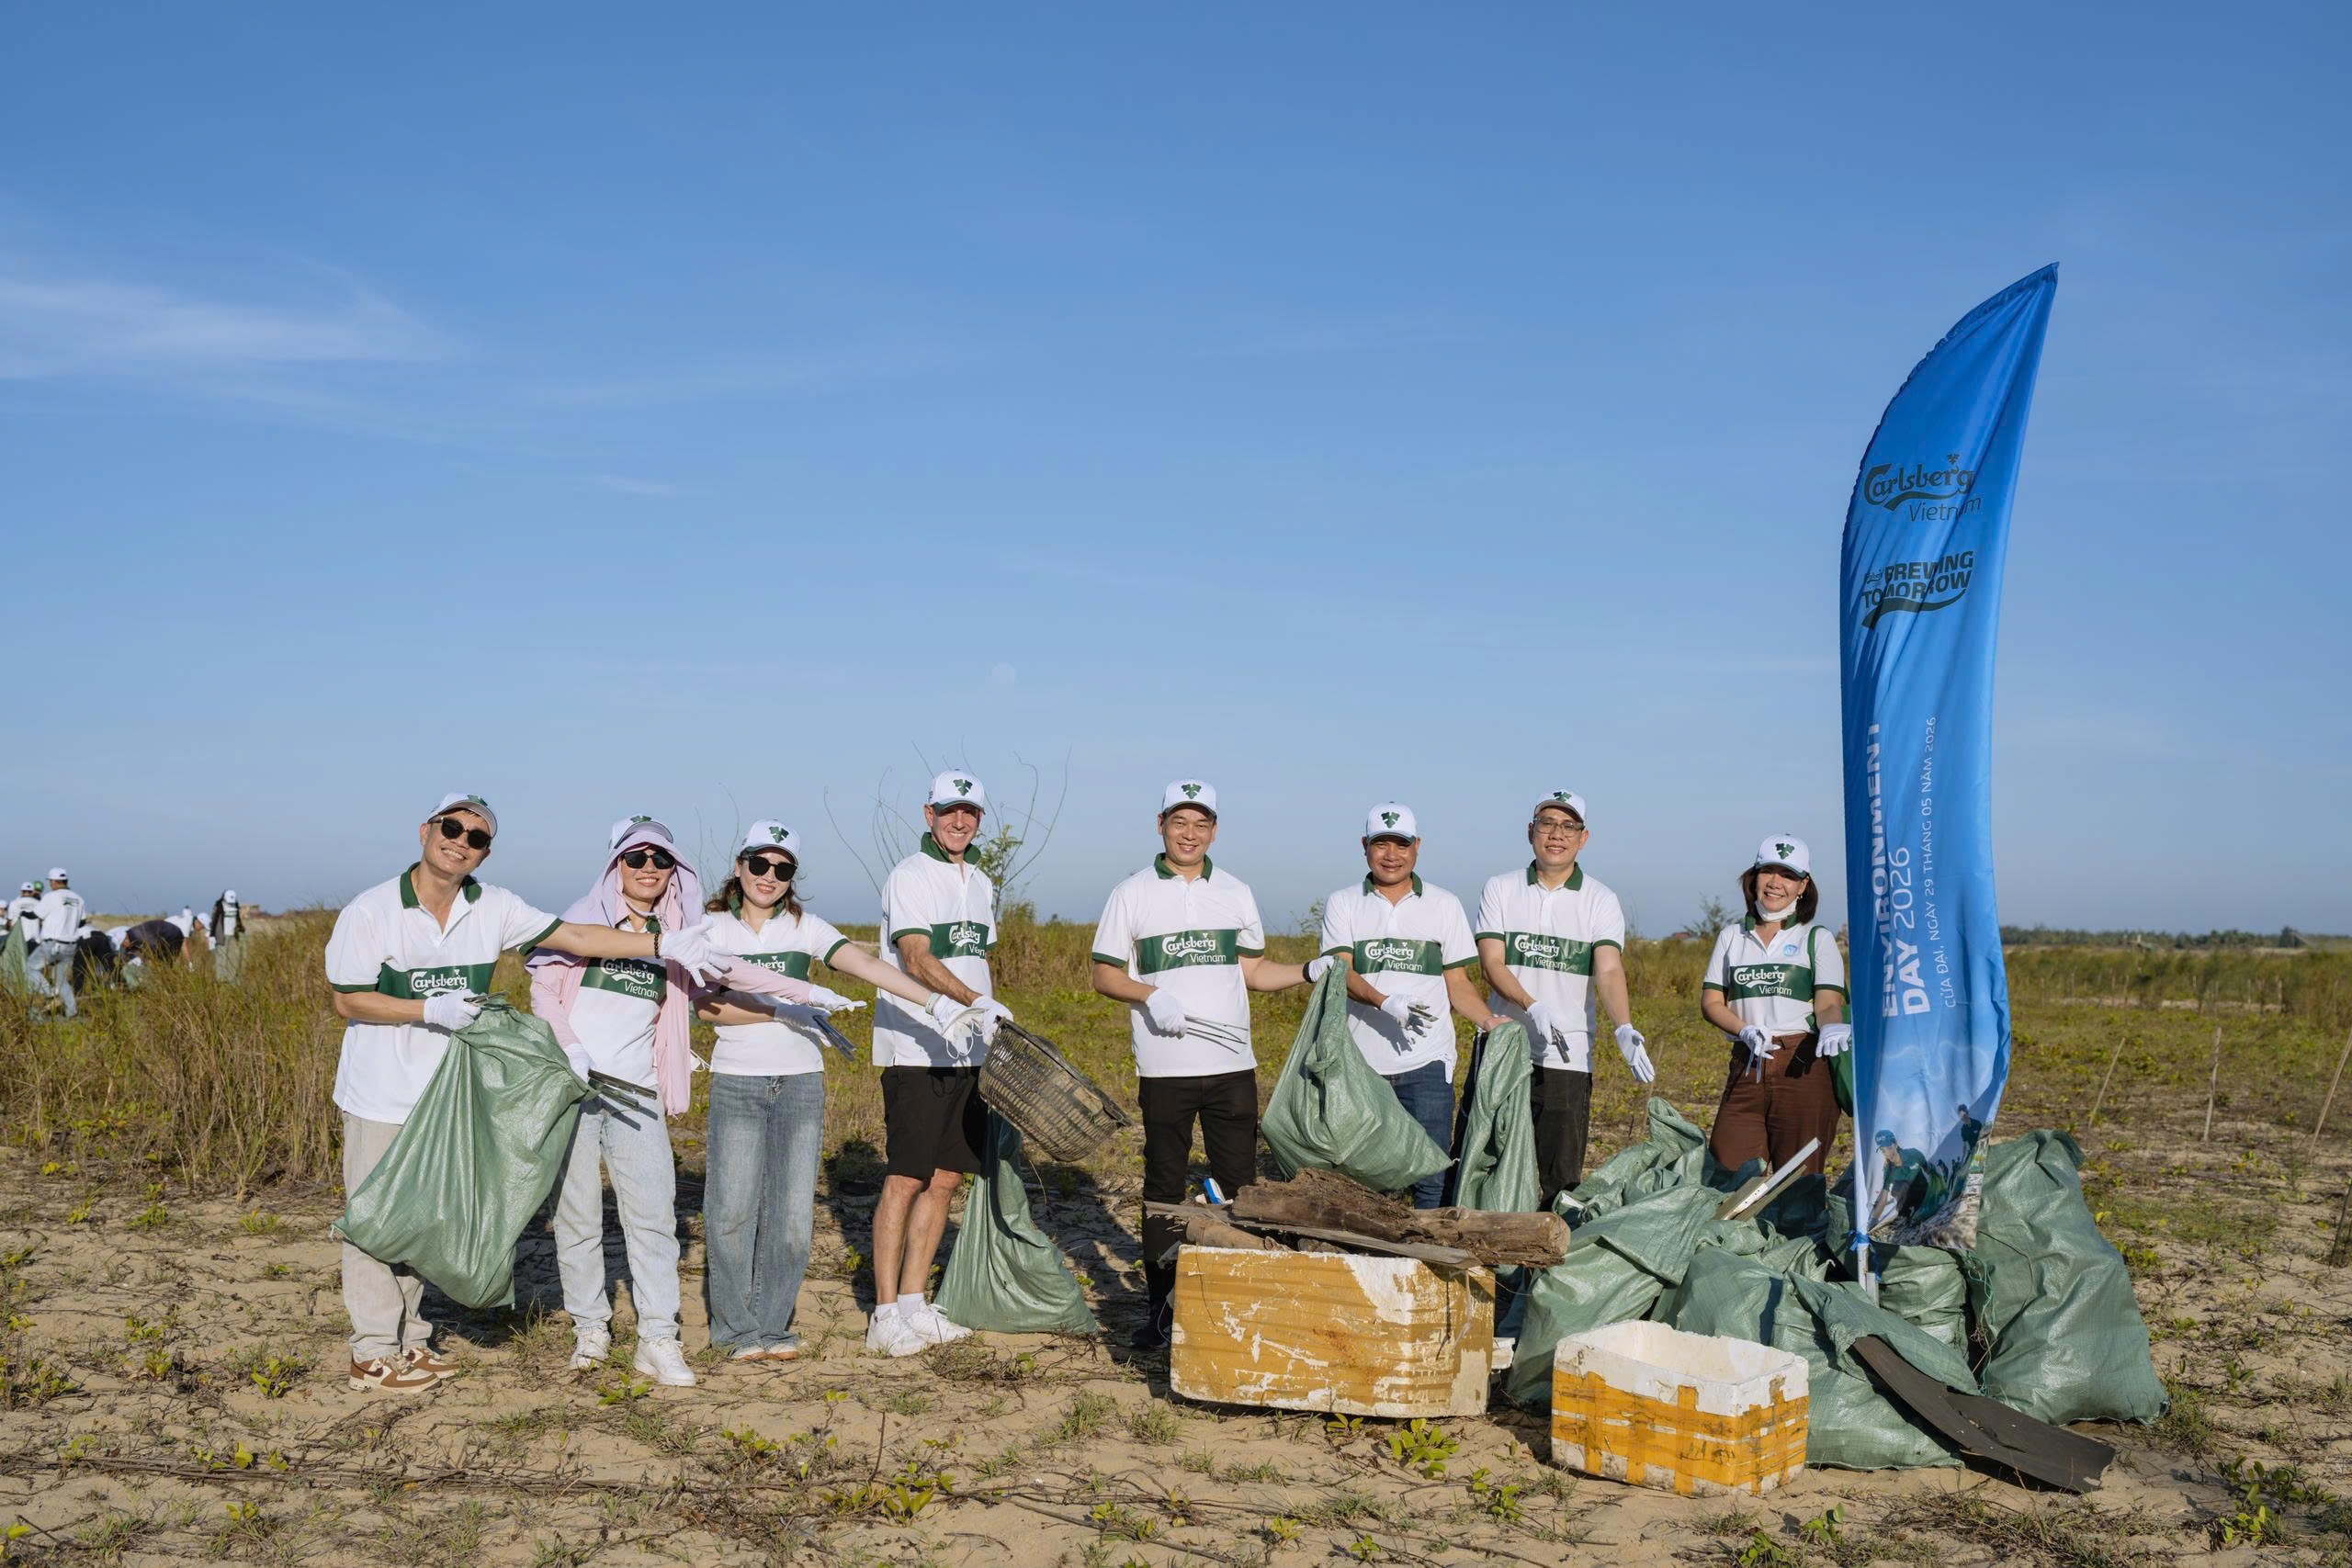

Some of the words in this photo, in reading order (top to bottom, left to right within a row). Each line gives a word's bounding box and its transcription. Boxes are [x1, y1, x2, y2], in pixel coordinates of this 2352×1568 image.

[1863, 463, 1973, 505] Carlsberg
[1909, 497, 1982, 522] Vietnm
[1925, 716, 1937, 751] 2026
[1921, 797, 1931, 816] 05
[1921, 821, 1933, 874] THÁNG
[1889, 847, 1916, 929] 2026
[1925, 879, 1934, 896] 29
[1927, 901, 1940, 941] NGÀY
[1162, 936, 1216, 955] Carlsberg
[1364, 942, 1414, 960] Carlsberg
[1513, 934, 1560, 957] Carlsberg
[1190, 954, 1227, 963] Vietnam
[1387, 959, 1423, 972] Vietnam
[411, 971, 468, 993] Carlsberg
[600, 959, 655, 985] Carlsberg
[1734, 967, 1786, 986] Carlsberg
[1895, 940, 1930, 1015] DAY
[1758, 985, 1792, 997] Vietnam
